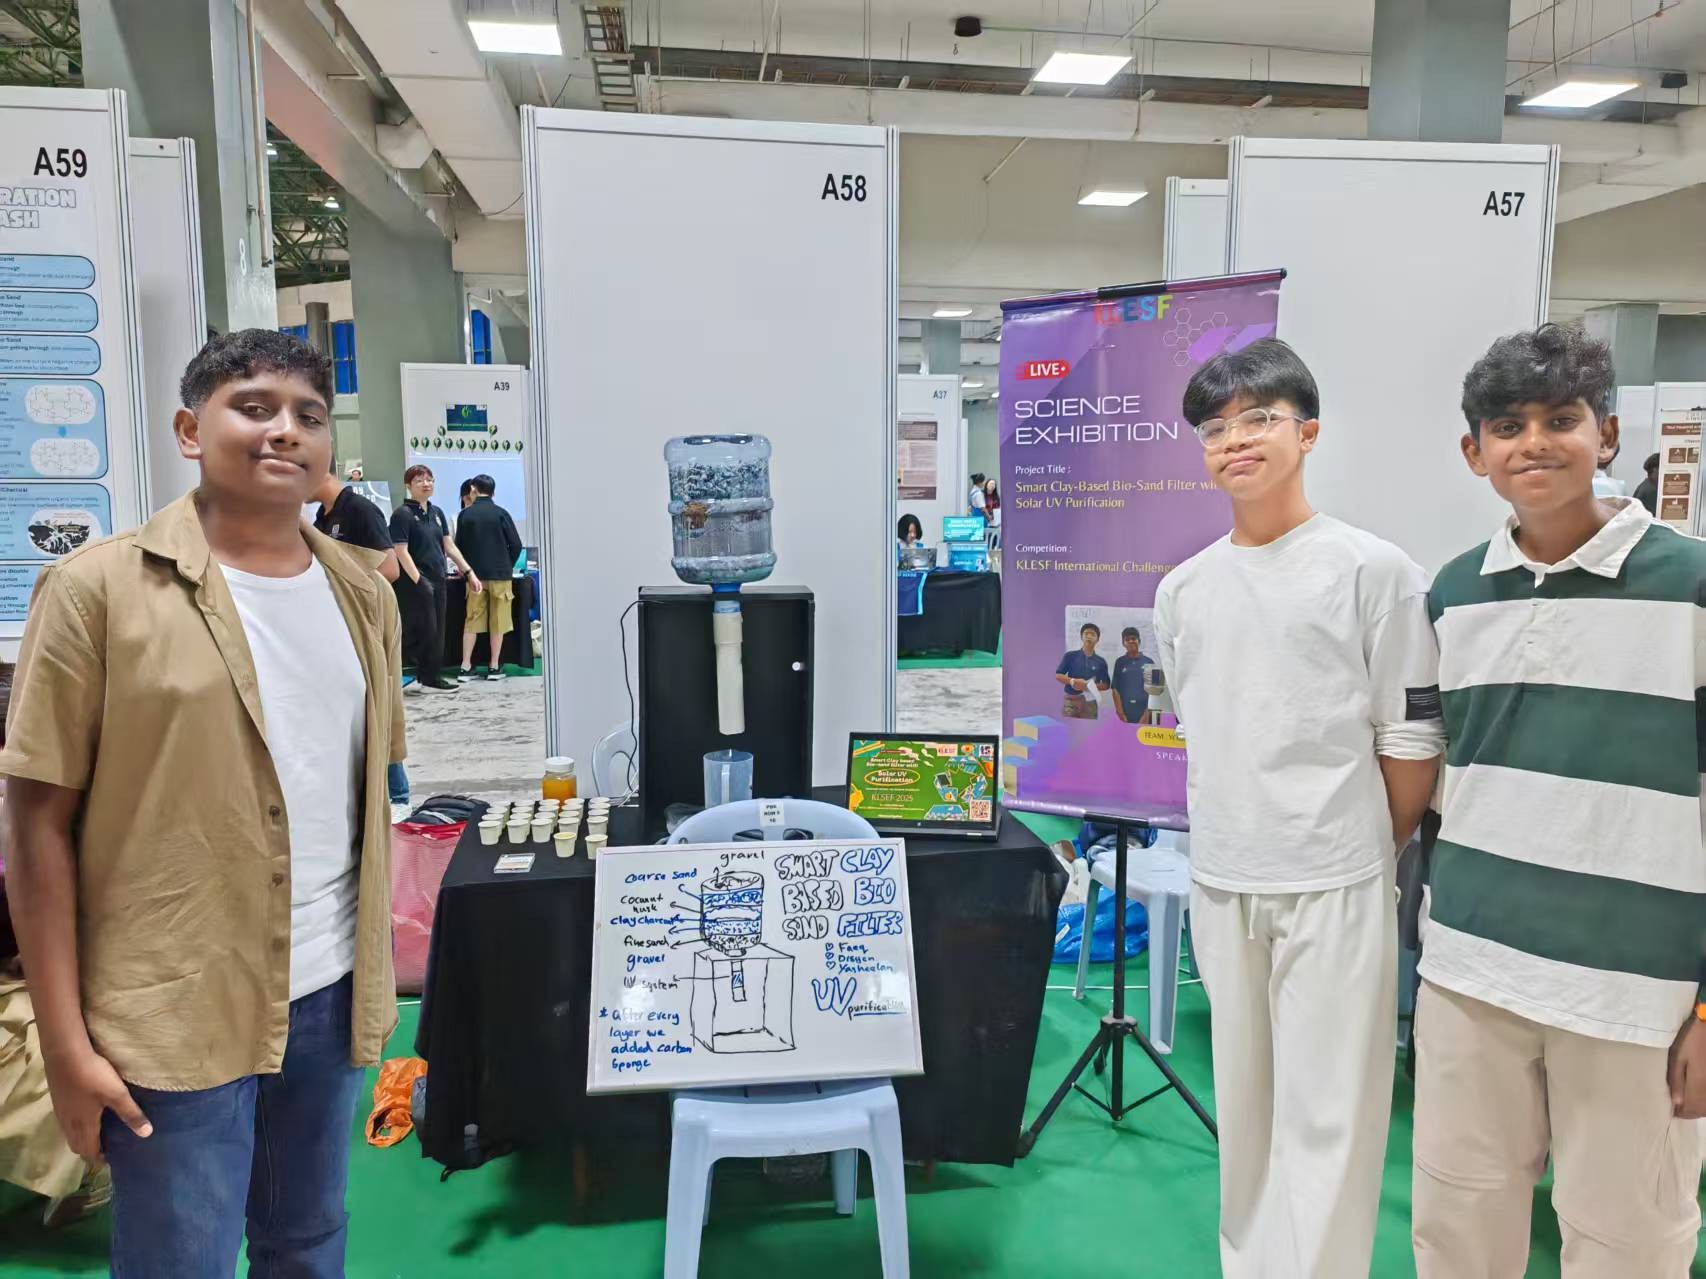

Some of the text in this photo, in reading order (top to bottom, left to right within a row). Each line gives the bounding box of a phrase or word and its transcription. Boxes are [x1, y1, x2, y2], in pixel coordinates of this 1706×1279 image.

[33, 147, 88, 178] A59
[821, 173, 867, 202] A58
[1483, 190, 1525, 217] A57
[1030, 363, 1060, 377] LIVE
[494, 381, 510, 391] A39
[933, 390, 947, 400] A37
[1015, 395, 1141, 419] SCIENCE
[1015, 422, 1179, 445] EXHIBITION
[1015, 465, 1045, 476] Project
[1047, 464, 1066, 474] Title
[1015, 481, 1048, 493] Smart
[1050, 480, 1109, 495] Clay-Based
[1112, 479, 1164, 491] Bio-Sand
[1167, 479, 1197, 491] Filter
[1015, 496, 1126, 509] Solar UV Purification
[1015, 543, 1068, 555] Competition
[1016, 559, 1052, 571] KLESF
[1054, 559, 1121, 573] International
[720, 850, 765, 867] gravel
[775, 847, 894, 881] SMART CLAY
[781, 877, 897, 915] BASED BIO
[782, 910, 904, 941] SAND FILTER
[626, 953, 666, 973] gravel
[811, 976, 858, 1017] UV
[647, 1011, 680, 1026] every
[609, 1026, 666, 1042] layer we
[611, 1041, 654, 1054] added
